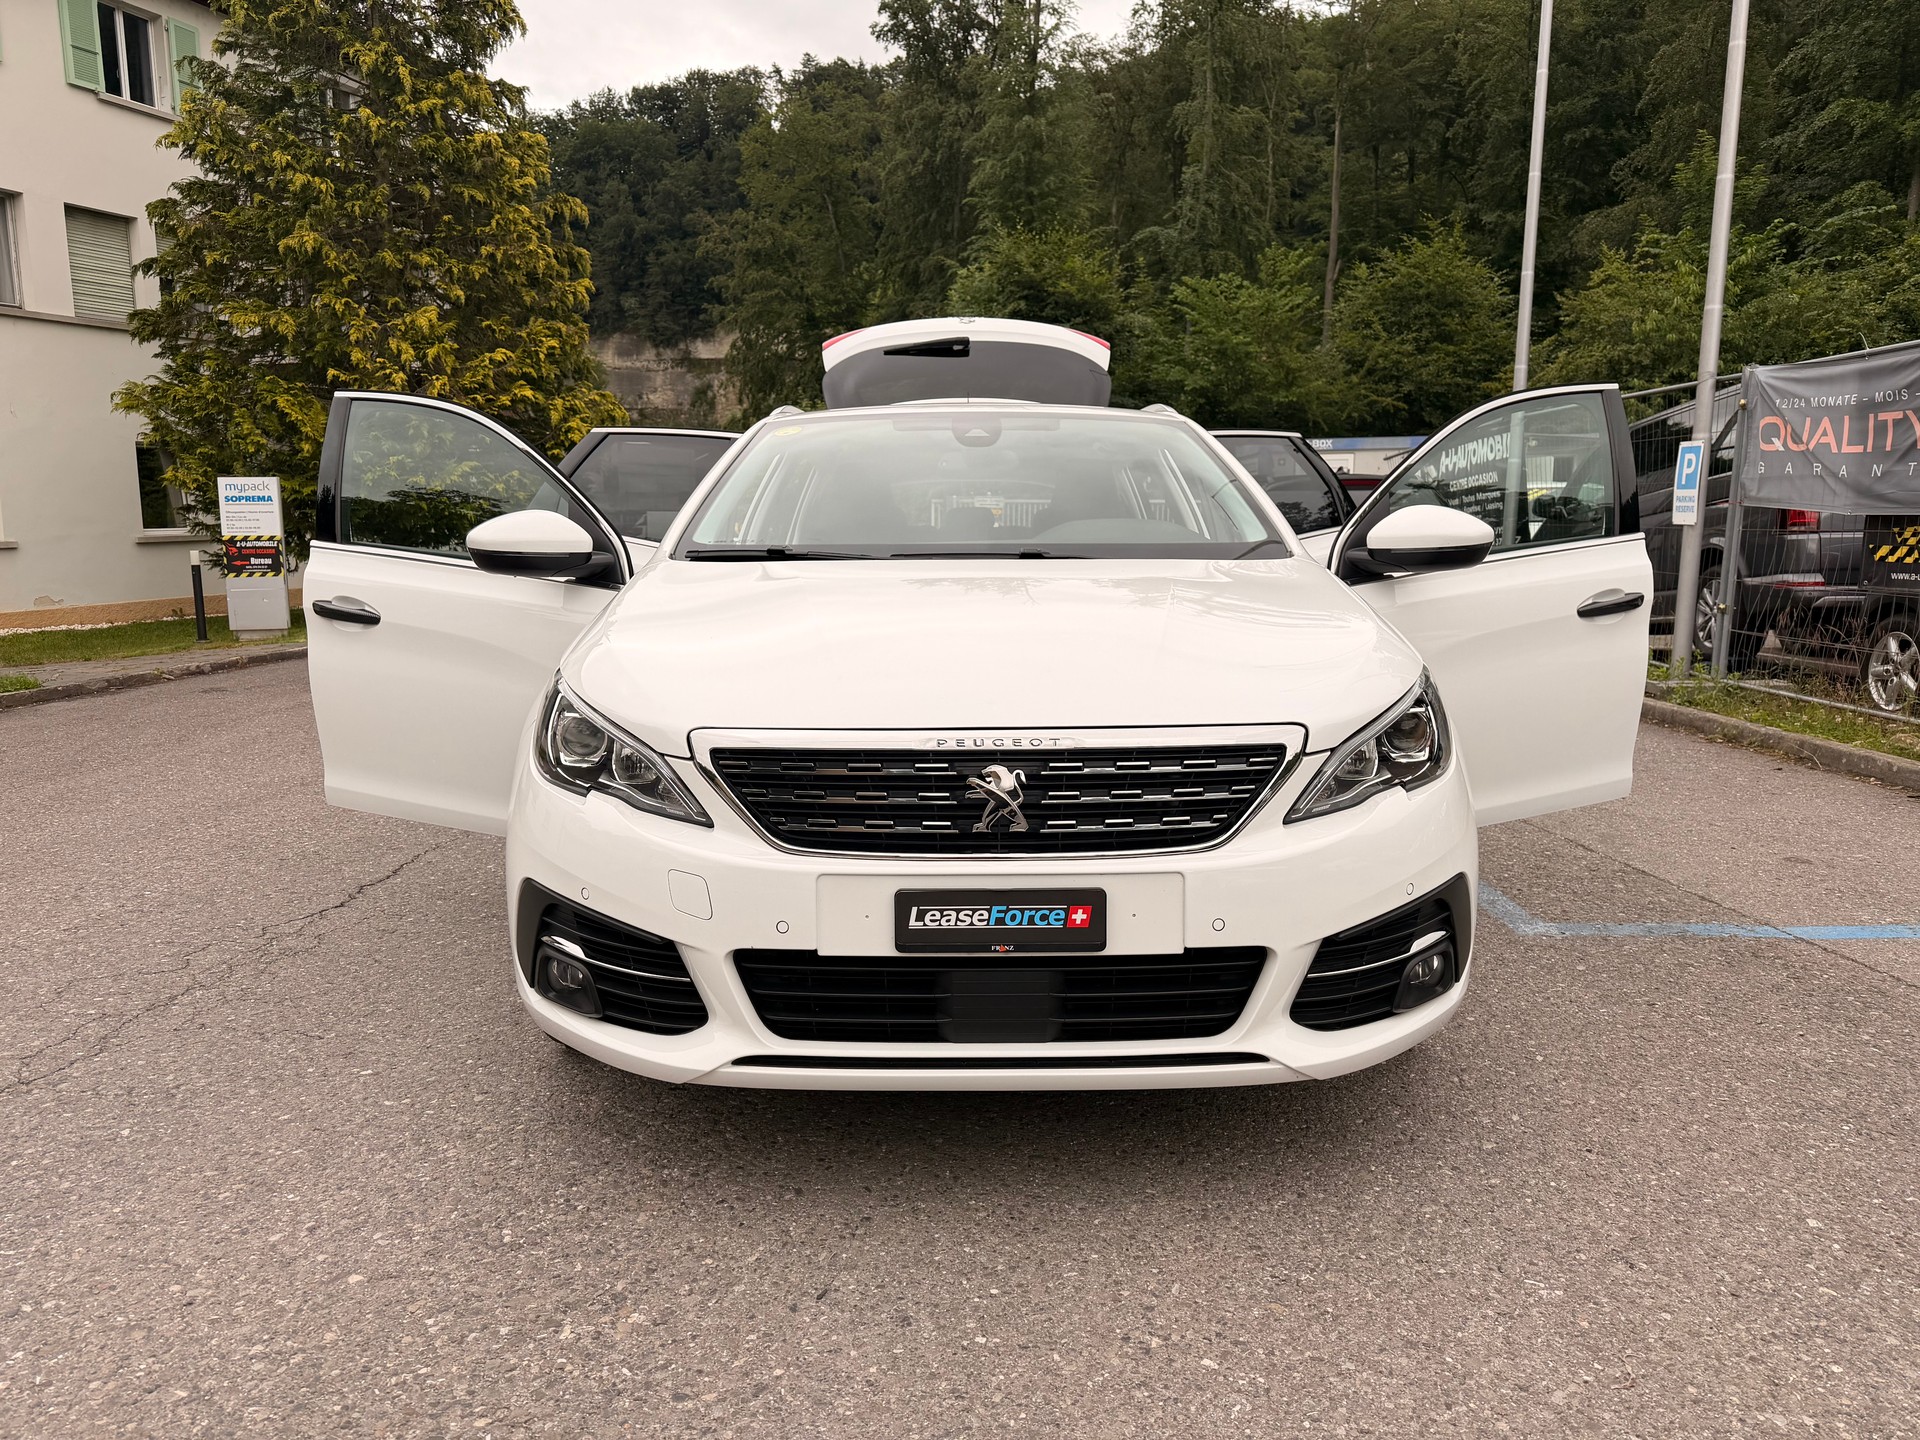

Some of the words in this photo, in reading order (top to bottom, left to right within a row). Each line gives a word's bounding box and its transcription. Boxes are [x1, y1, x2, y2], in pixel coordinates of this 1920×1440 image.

[1775, 398, 1806, 409] 12/24
[1811, 394, 1857, 408] MONATE
[1875, 388, 1909, 402] MOIS
[1682, 453, 1697, 485] P
[1468, 471, 1499, 488] OCCASION
[225, 481, 270, 493] mypack
[224, 495, 273, 503] SOPREMA
[250, 557, 272, 565] Bureau
[936, 738, 1061, 747] PEUGEOT
[908, 905, 1065, 926] LeaseForce
